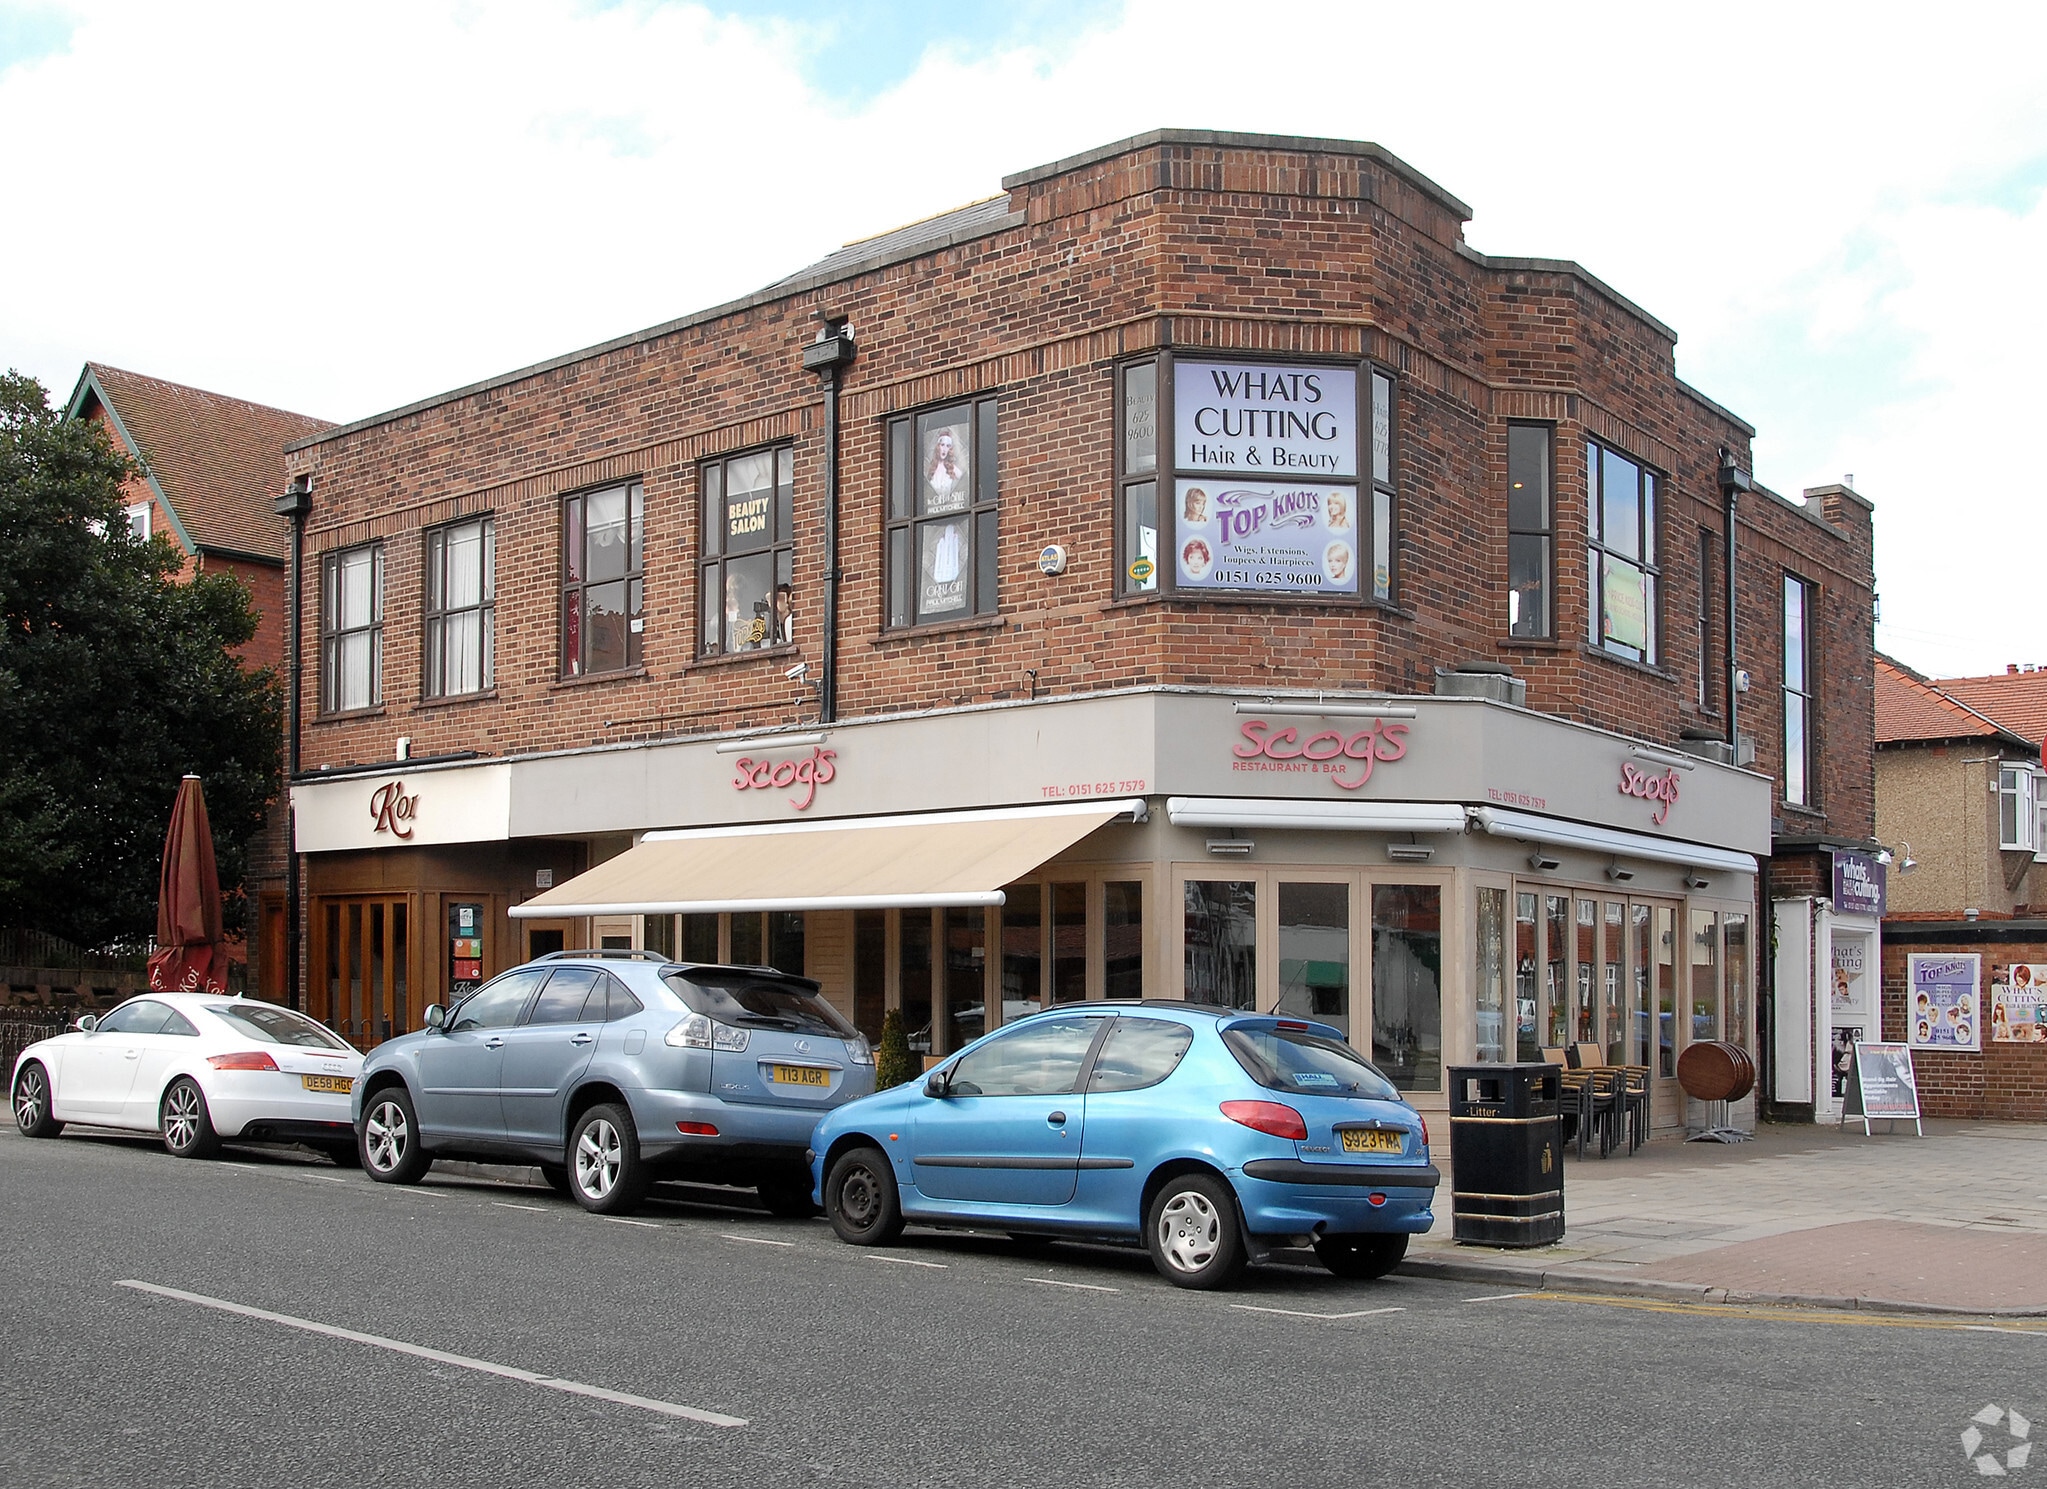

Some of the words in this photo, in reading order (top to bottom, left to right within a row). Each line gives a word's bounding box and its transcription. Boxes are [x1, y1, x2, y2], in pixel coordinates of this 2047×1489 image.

[1211, 370, 1322, 403] WHATS
[1133, 410, 1149, 423] 625
[1194, 407, 1337, 440] CUTTING
[1128, 425, 1153, 440] 9600
[1375, 421, 1387, 437] 625
[1246, 446, 1262, 465] &
[729, 498, 769, 519] BEAUTY
[730, 514, 766, 535] SALON
[1216, 504, 1266, 544] TOP
[1273, 491, 1319, 519] KNOTS
[1270, 557, 1315, 567] Hairpieces
[1215, 570, 1249, 583] 0151
[1256, 572, 1281, 584] 625
[1287, 573, 1322, 585] 9600
[1232, 718, 1410, 789] Scog's
[1233, 762, 1308, 772] RESTAURANT
[1311, 763, 1319, 773] &
[1323, 764, 1346, 773] BAR
[732, 746, 837, 810] Scog's
[1042, 786, 1065, 797] TEL:
[1069, 784, 1091, 796] 0151
[1095, 782, 1115, 794] 625
[1119, 780, 1145, 792] 7579
[1618, 762, 1680, 825] Scog's
[1503, 791, 1517, 803] 0151
[370, 781, 420, 839] Koi
[1831, 946, 1862, 957] hat's
[1831, 958, 1862, 970] tting
[179, 966, 199, 992] Koi
[1920, 967, 1942, 982] TOP
[1997, 994, 2045, 1003] CUTTING
[307, 1077, 332, 1089] DE58
[801, 1070, 822, 1084] AGR
[1470, 1107, 1497, 1118] Litter
[1344, 1131, 1377, 1147] S923
